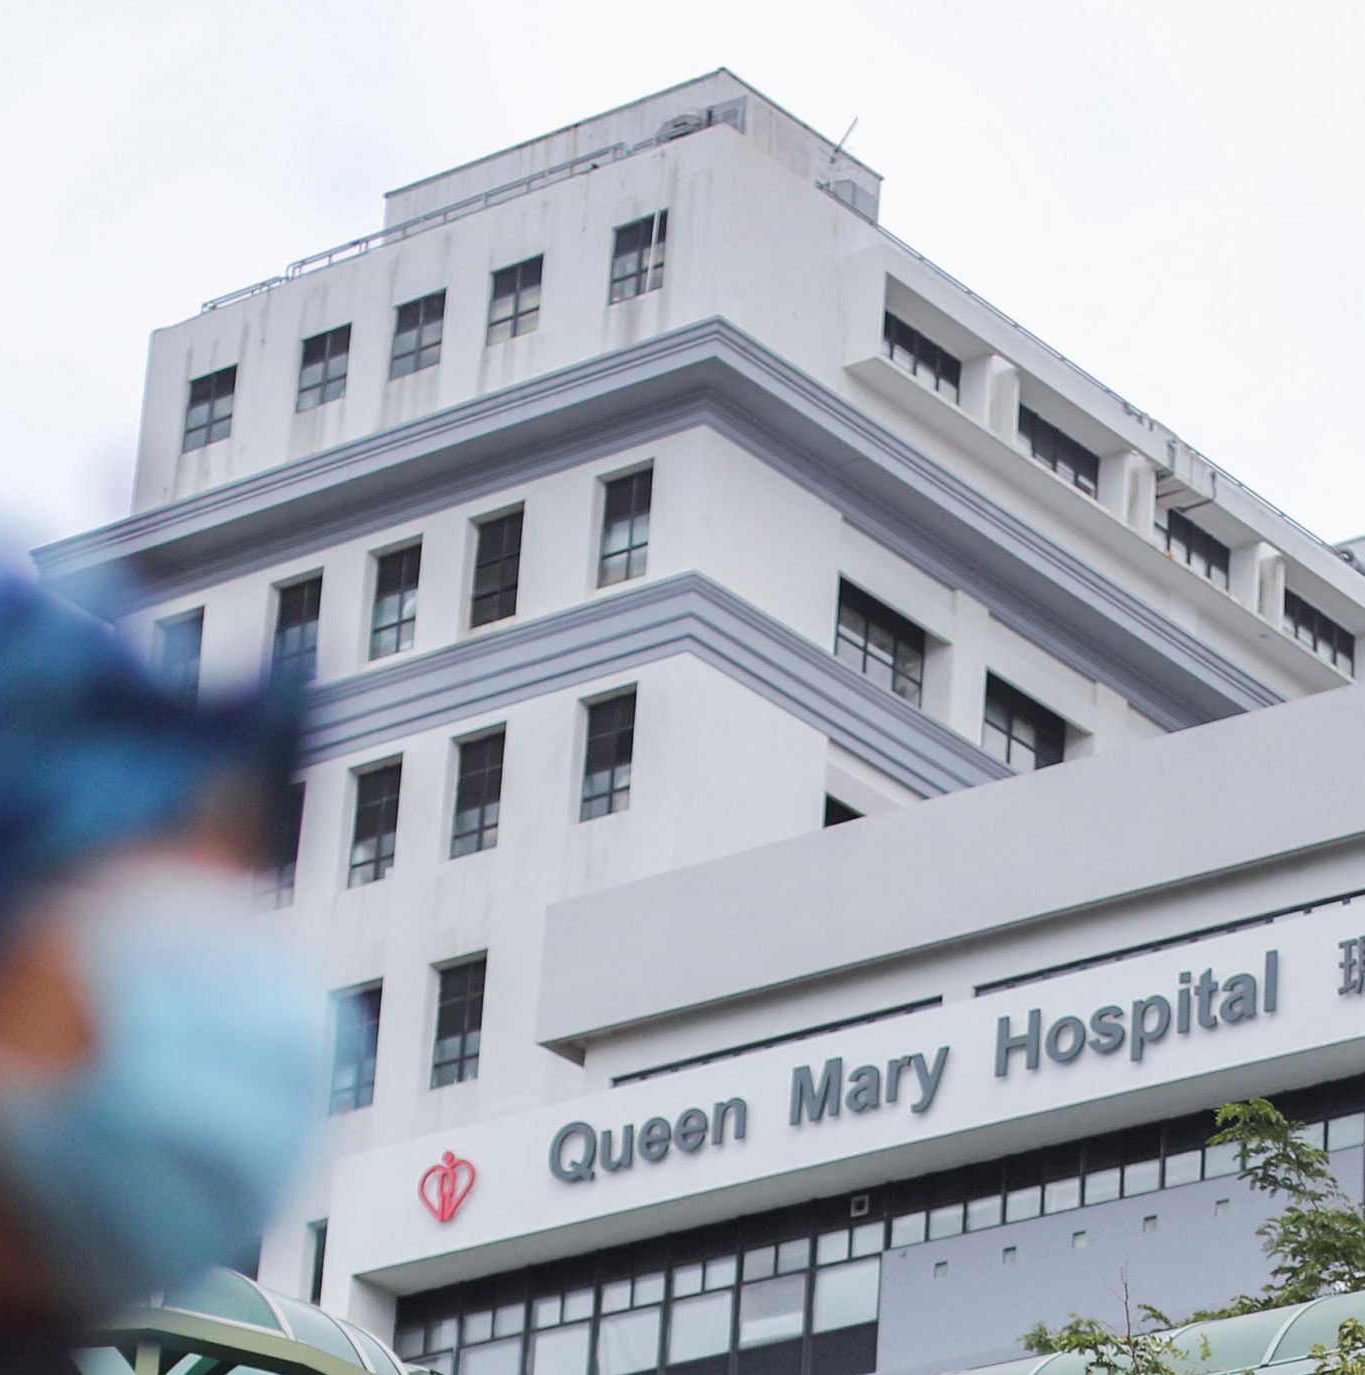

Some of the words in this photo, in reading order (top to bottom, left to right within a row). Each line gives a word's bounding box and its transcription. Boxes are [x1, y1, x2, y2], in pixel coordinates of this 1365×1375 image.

[548, 1096, 748, 1185] Queen
[788, 1045, 950, 1127] Mary
[993, 949, 1280, 1080] Hospital
